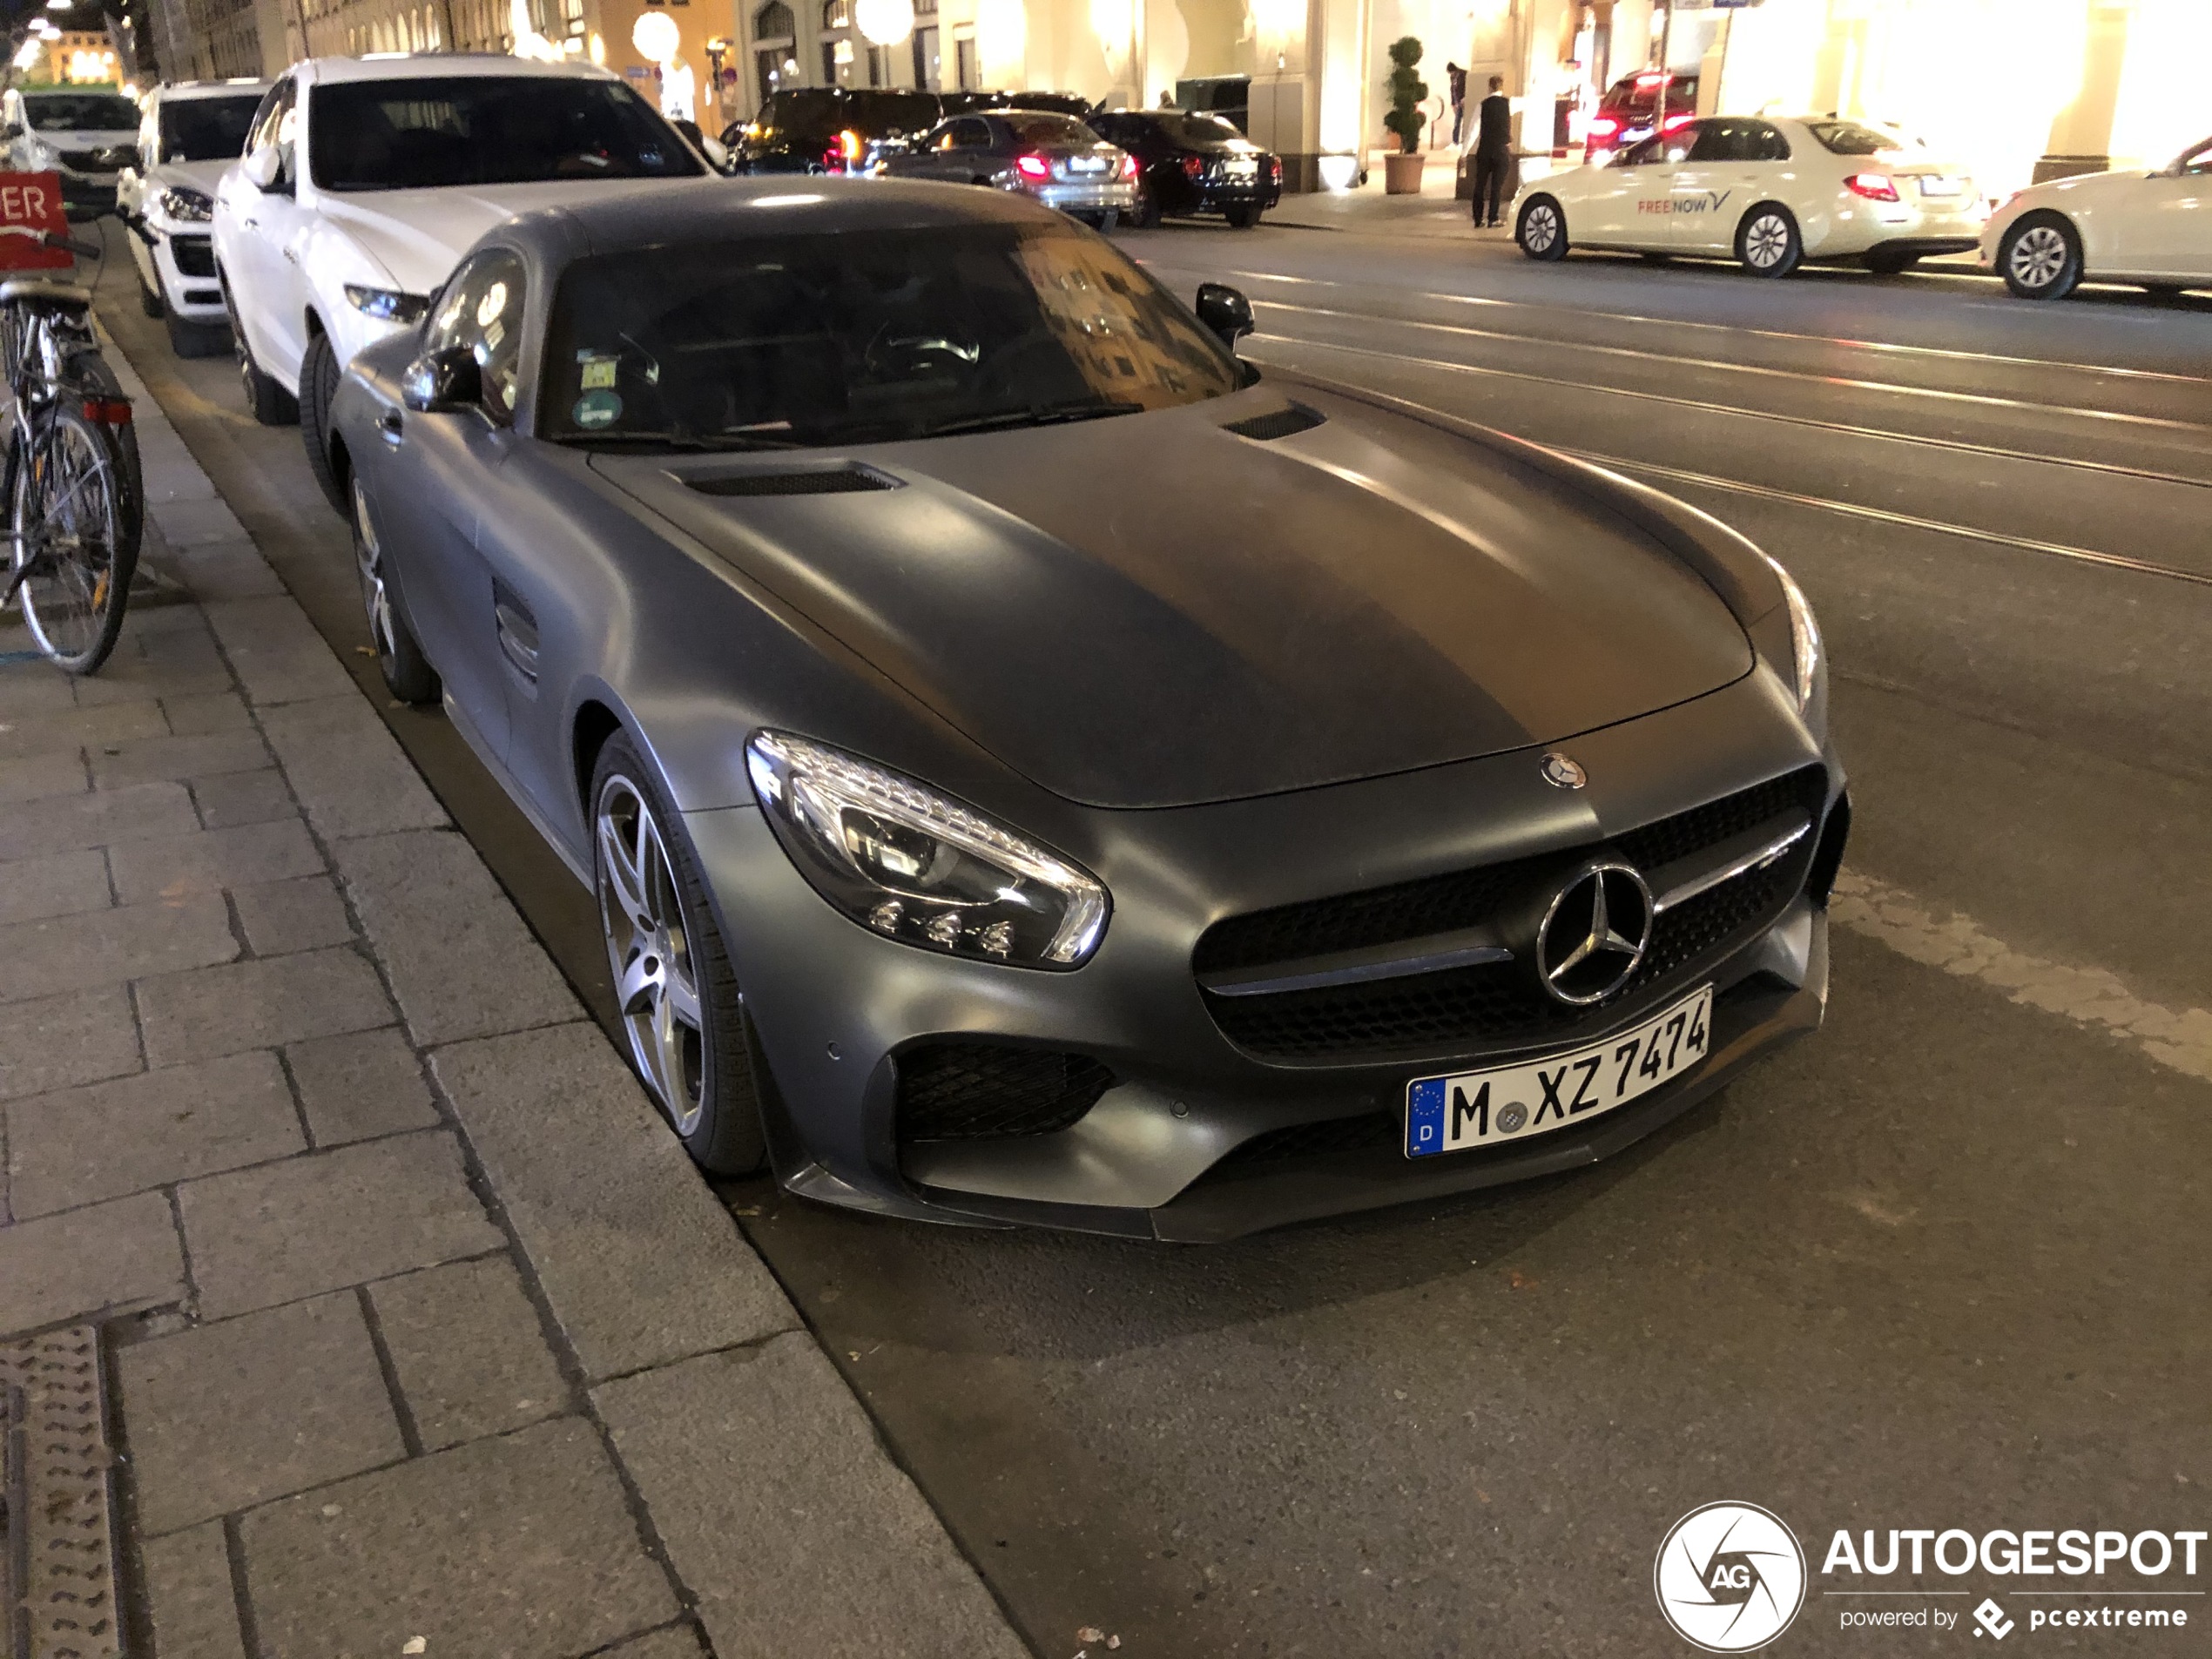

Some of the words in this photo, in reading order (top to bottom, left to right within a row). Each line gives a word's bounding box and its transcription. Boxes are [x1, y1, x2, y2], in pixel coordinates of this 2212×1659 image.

[1451, 1082, 1490, 1140] M
[1534, 1055, 1601, 1124] XZ
[1615, 1001, 1705, 1097] 7474
[1420, 1124, 1433, 1142] D
